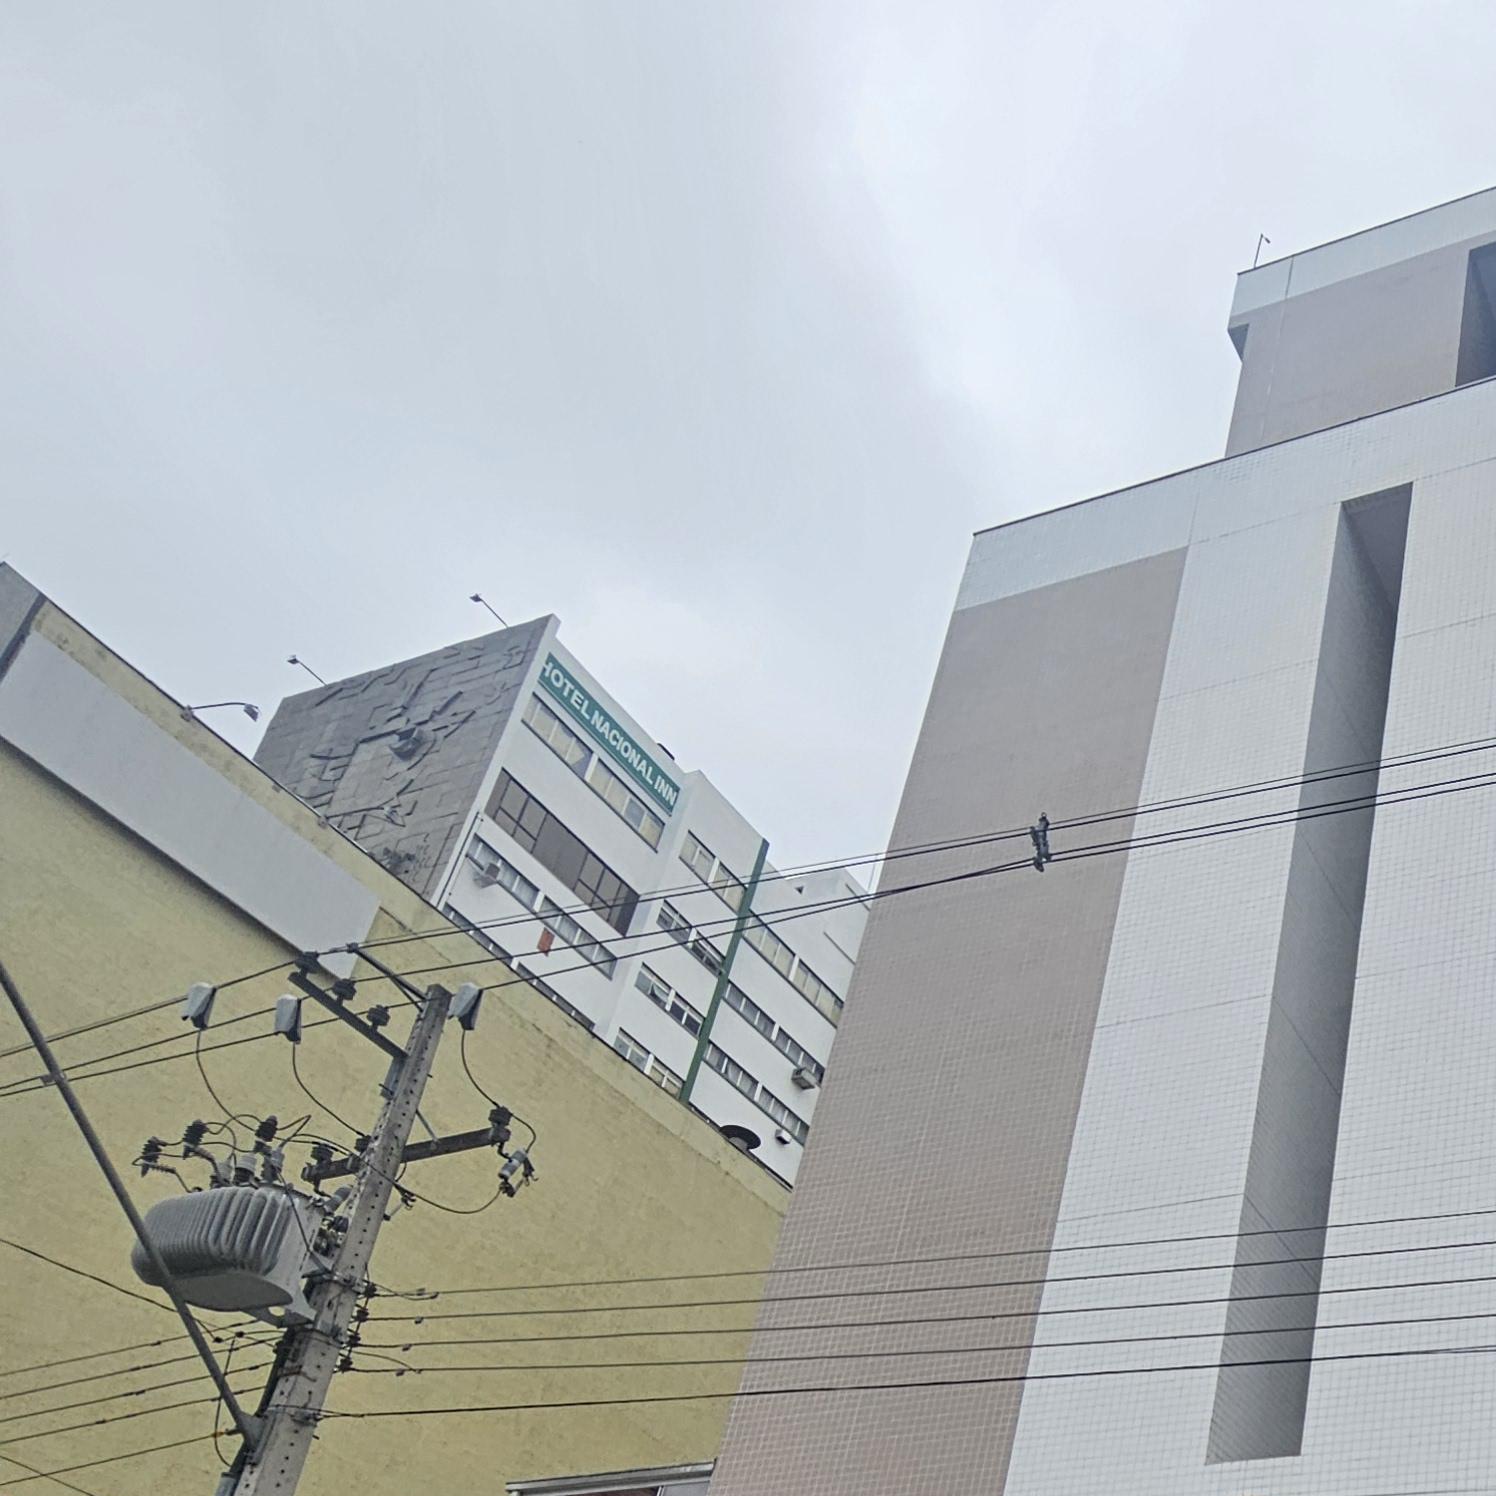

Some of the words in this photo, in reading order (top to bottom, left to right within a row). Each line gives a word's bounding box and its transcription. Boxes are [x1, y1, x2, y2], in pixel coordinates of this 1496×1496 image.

[542, 662, 591, 719] HOTEL
[591, 710, 653, 784] NACIONAL
[654, 775, 677, 805] INN
